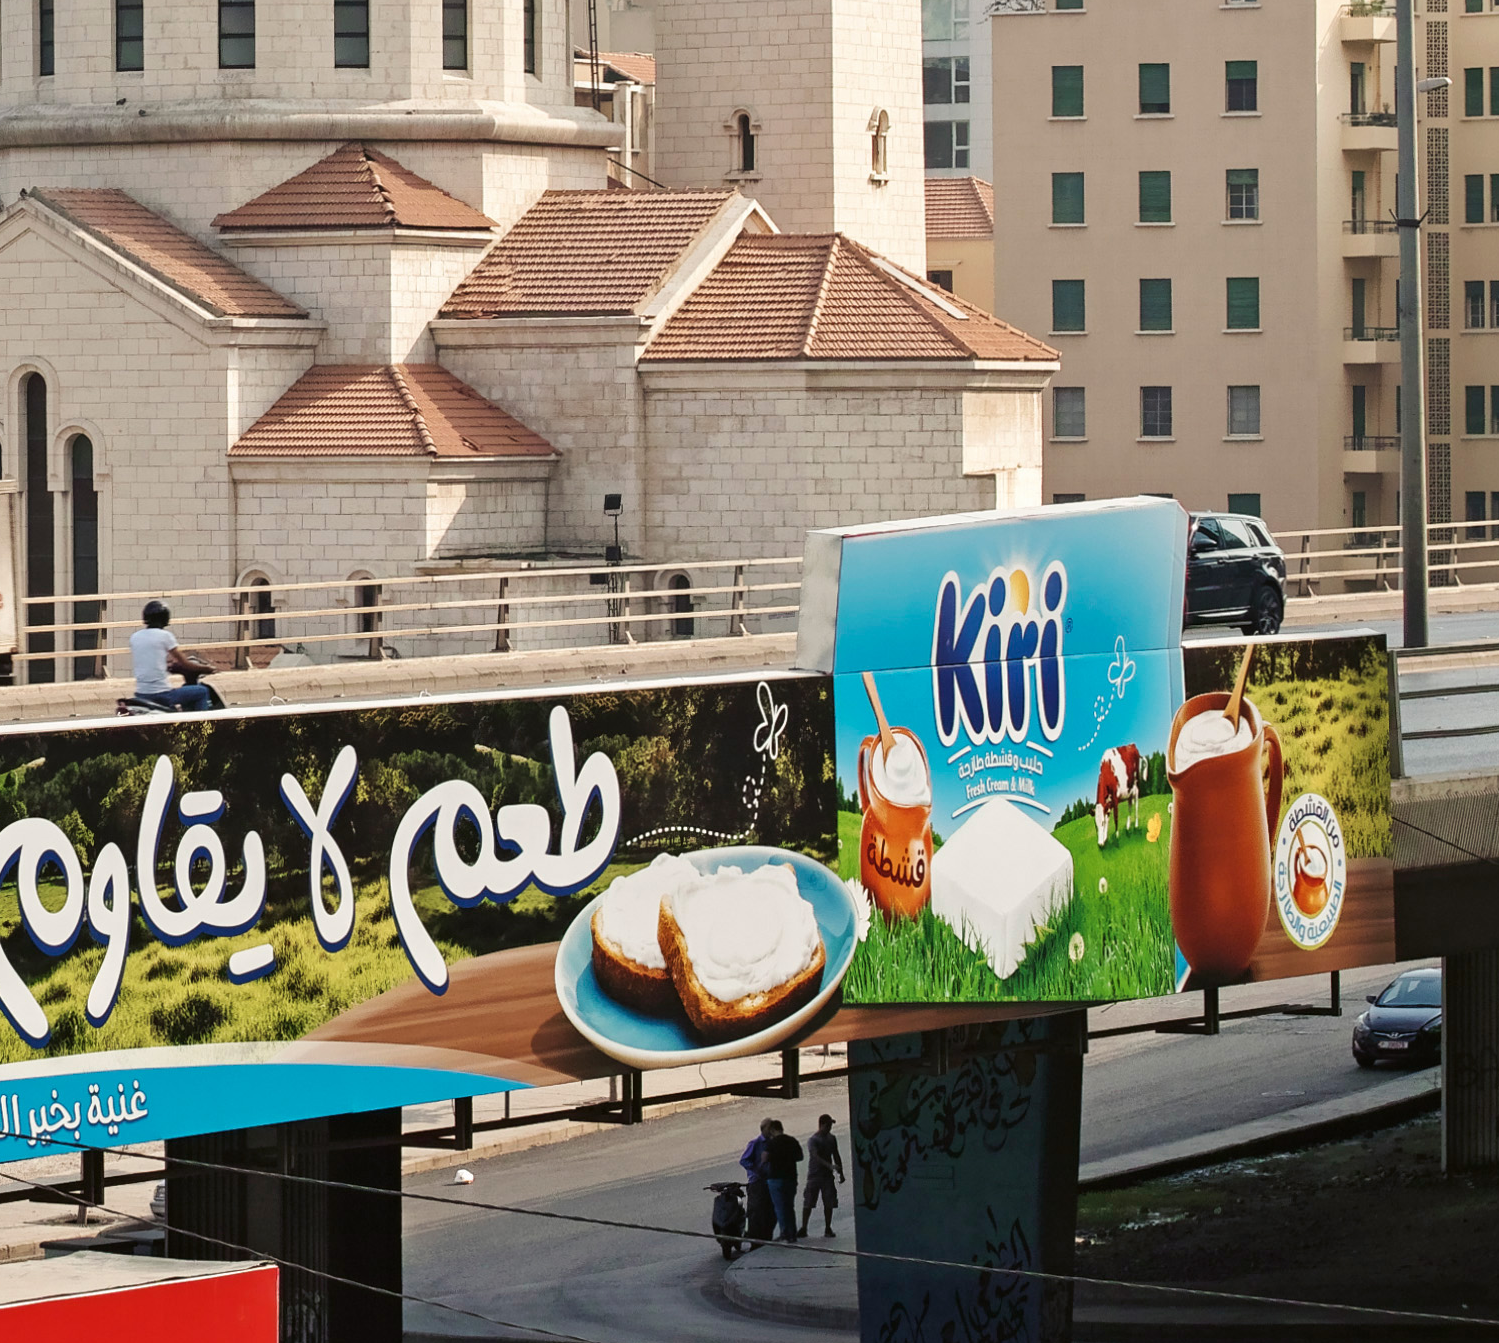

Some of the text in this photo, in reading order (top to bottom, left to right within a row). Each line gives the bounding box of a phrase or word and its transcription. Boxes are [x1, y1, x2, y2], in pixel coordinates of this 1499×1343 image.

[931, 559, 1069, 748] Kiri
[957, 755, 985, 779] طازجة
[965, 777, 986, 800] Fresh
[986, 777, 1010, 793] Cream
[1018, 777, 1035, 796] Milk
[1019, 754, 1044, 776] حليب
[279, 744, 360, 953] لا
[388, 705, 622, 997] طعم
[865, 834, 927, 889] قشطة
[27, 1088, 82, 1147] بخير
[87, 1079, 149, 1136] غنية
